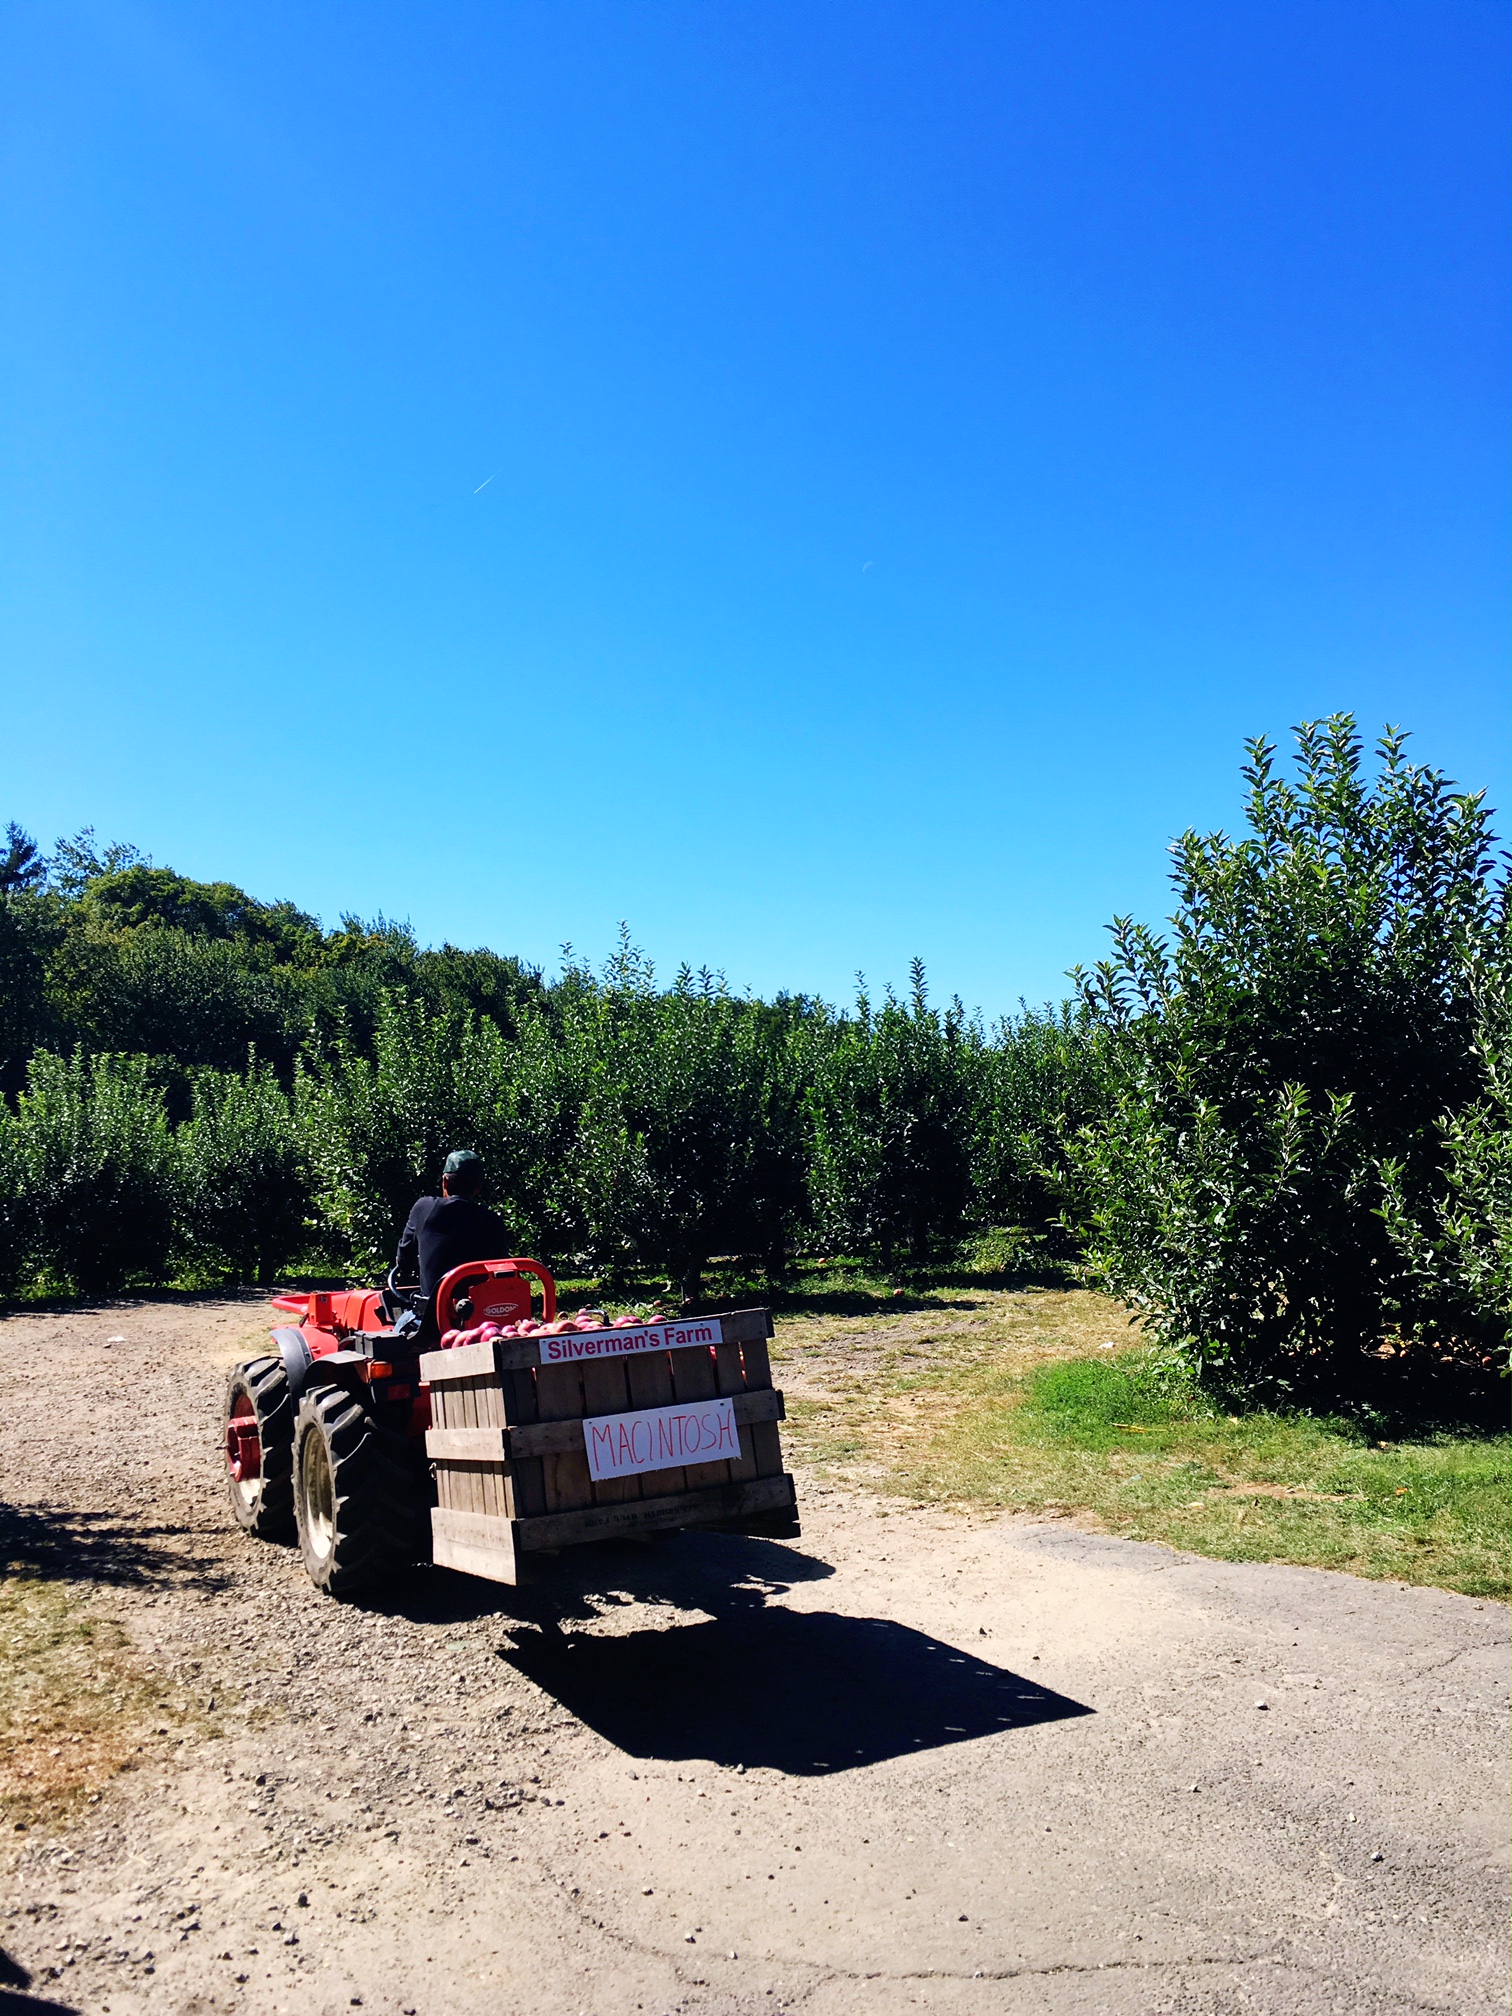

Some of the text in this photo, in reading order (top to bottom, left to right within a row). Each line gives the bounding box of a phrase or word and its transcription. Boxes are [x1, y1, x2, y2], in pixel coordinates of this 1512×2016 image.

[548, 1325, 713, 1360] Silverman's Farm
[591, 1409, 735, 1472] MACINTOSH
